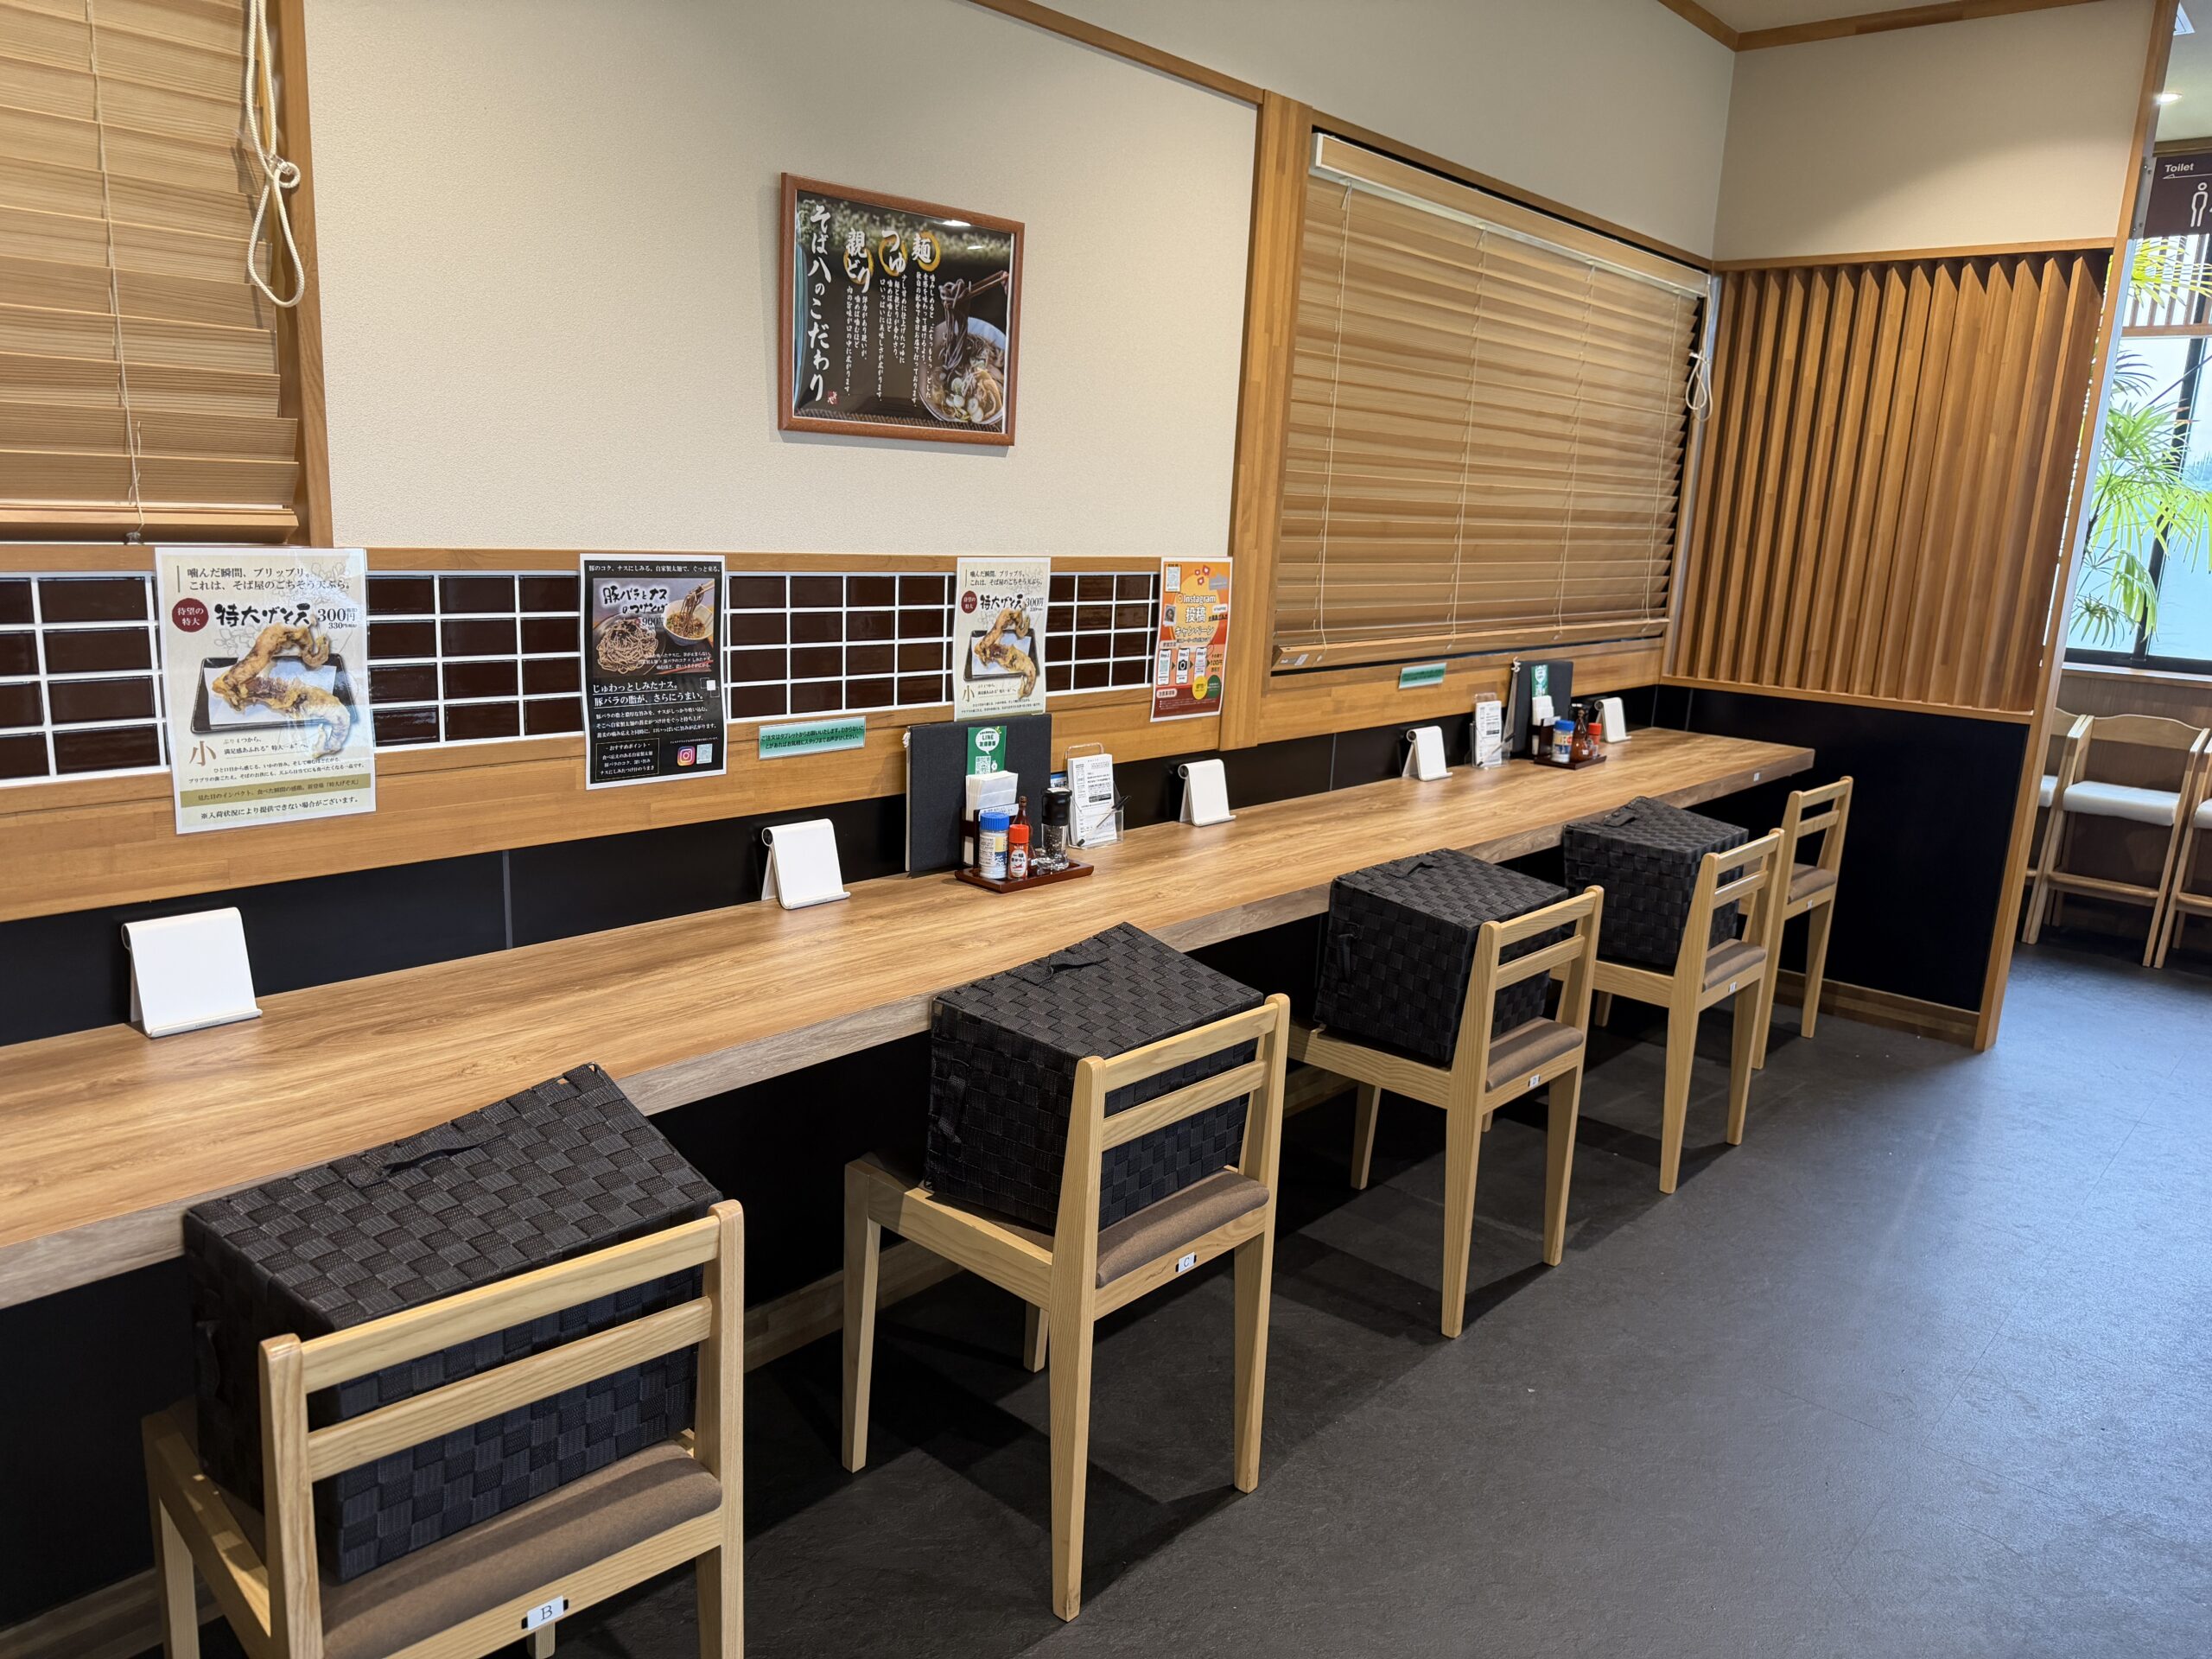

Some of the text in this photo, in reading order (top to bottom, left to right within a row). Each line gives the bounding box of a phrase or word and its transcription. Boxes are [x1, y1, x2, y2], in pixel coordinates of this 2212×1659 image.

[2164, 162, 2194, 173] Toilet
[881, 230, 906, 273] つゆ
[912, 232, 931, 264] 麺
[846, 227, 870, 293] 親どり
[808, 205, 831, 401] そば八のこだわり
[602, 585, 668, 604] 豚バラとナス
[1183, 594, 1216, 605] Instagram
[214, 603, 311, 627] 特大げそ天
[1185, 607, 1206, 622] 投稿
[1175, 626, 1214, 637] キャンペーン
[593, 681, 677, 693] じゅわっとしみたナス。
[594, 692, 703, 707] 豚バラの脂が、さらにうまい。
[1183, 1257, 1190, 1267] C
[540, 1605, 553, 1621] B
